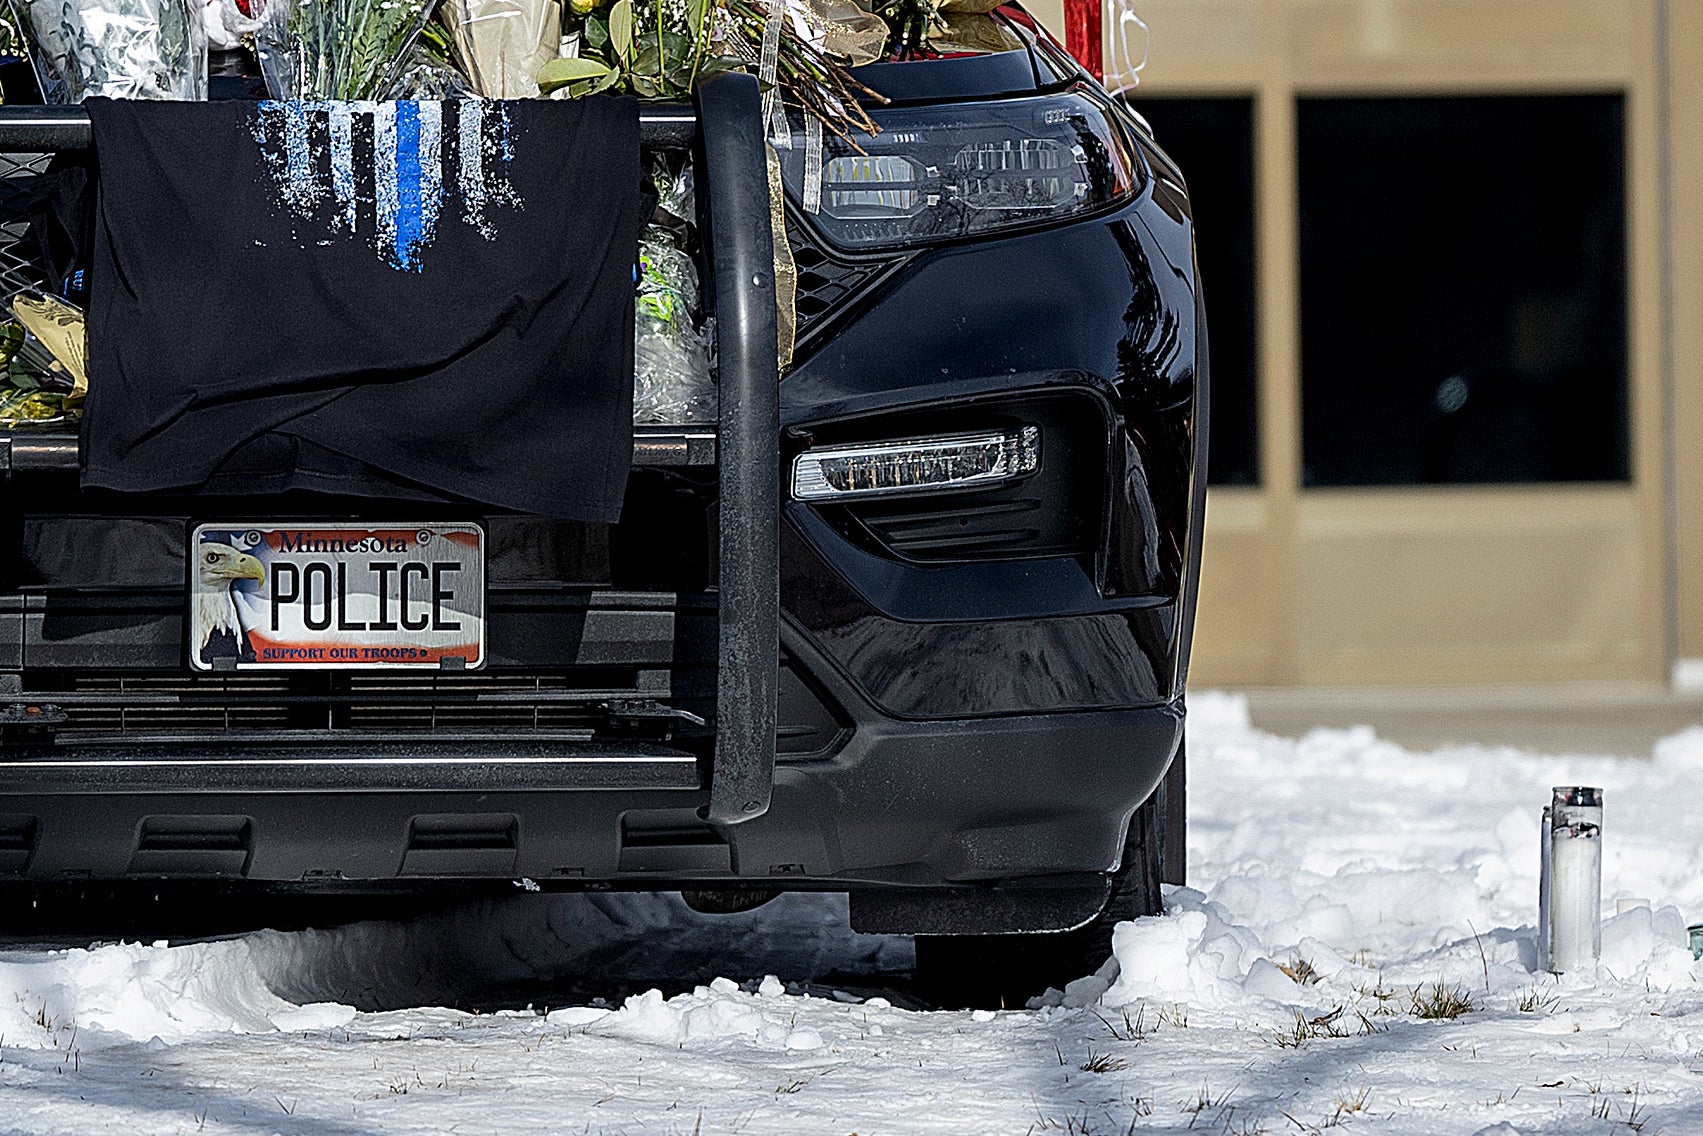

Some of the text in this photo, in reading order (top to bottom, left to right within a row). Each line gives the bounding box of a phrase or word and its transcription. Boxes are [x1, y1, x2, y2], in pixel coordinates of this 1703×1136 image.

[278, 532, 409, 553] Minnesota
[270, 561, 462, 632] POLICE
[262, 647, 417, 659] SUPPORT OUR TROOPS
